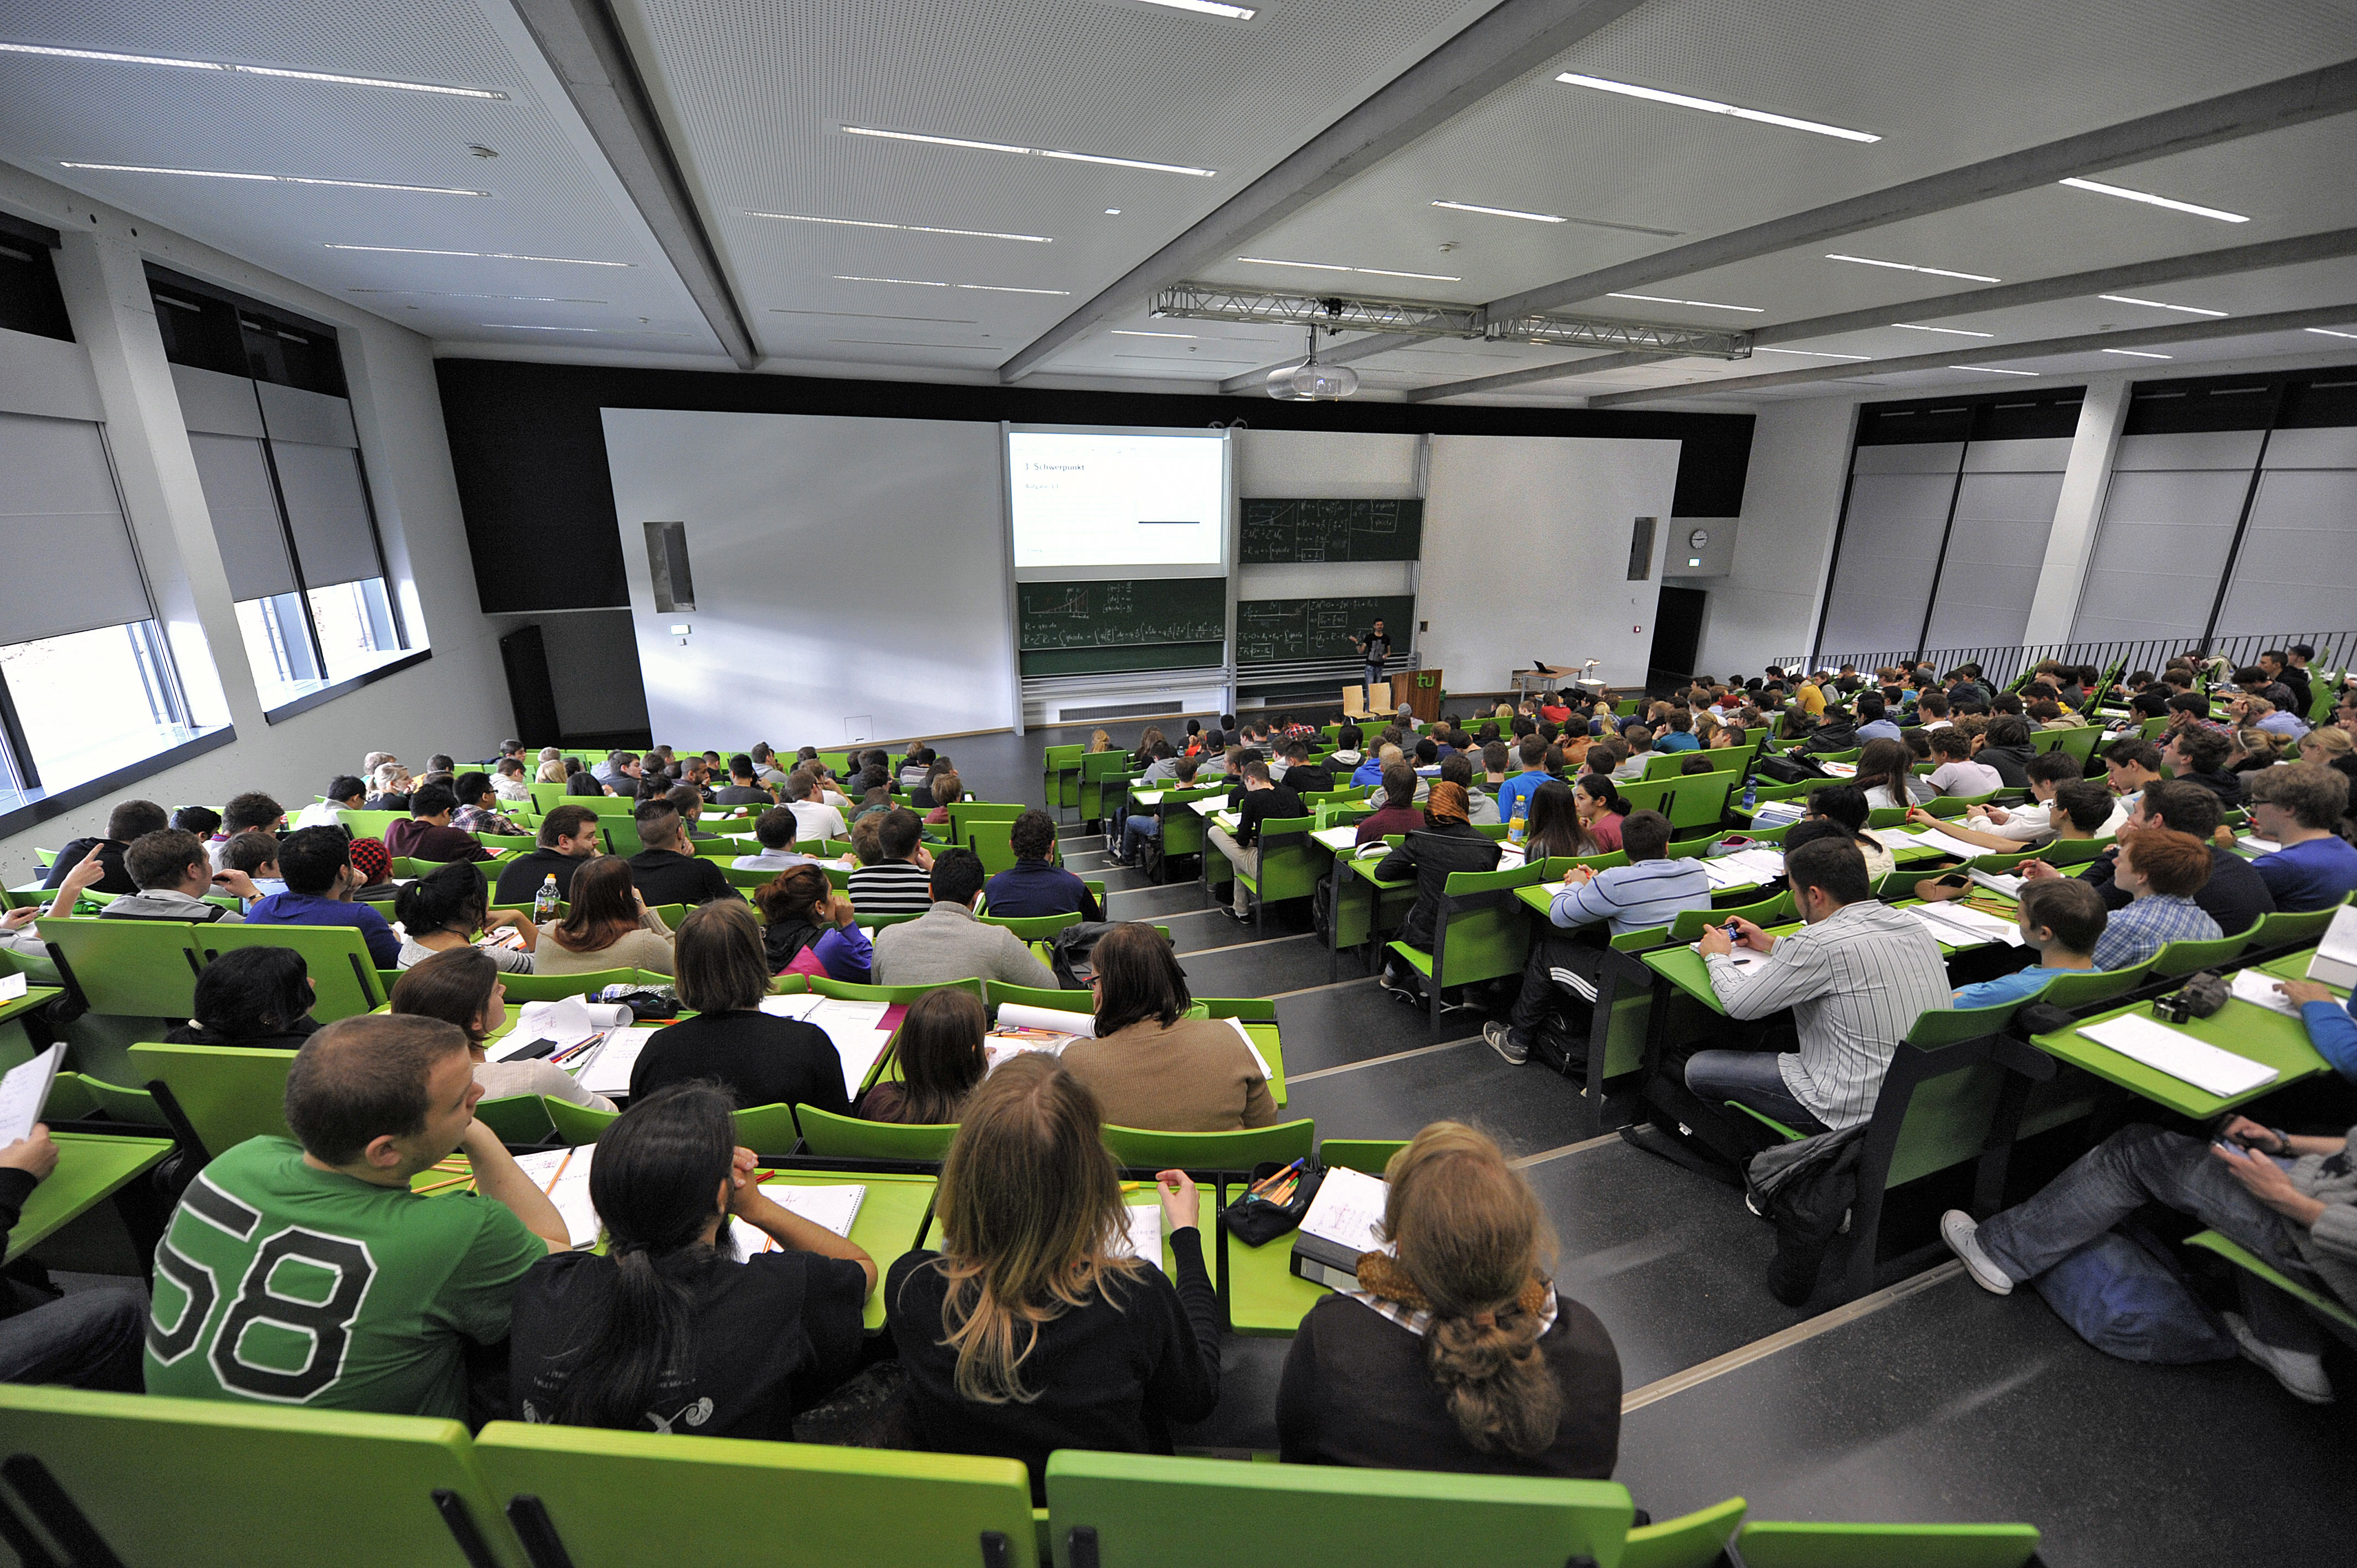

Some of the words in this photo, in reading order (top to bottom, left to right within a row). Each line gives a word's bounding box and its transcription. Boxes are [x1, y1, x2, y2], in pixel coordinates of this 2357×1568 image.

[1025, 462, 1029, 471] 3
[1034, 462, 1085, 472] Schwerpunkt
[1417, 673, 1435, 688] tu
[144, 1169, 378, 1405] 58
